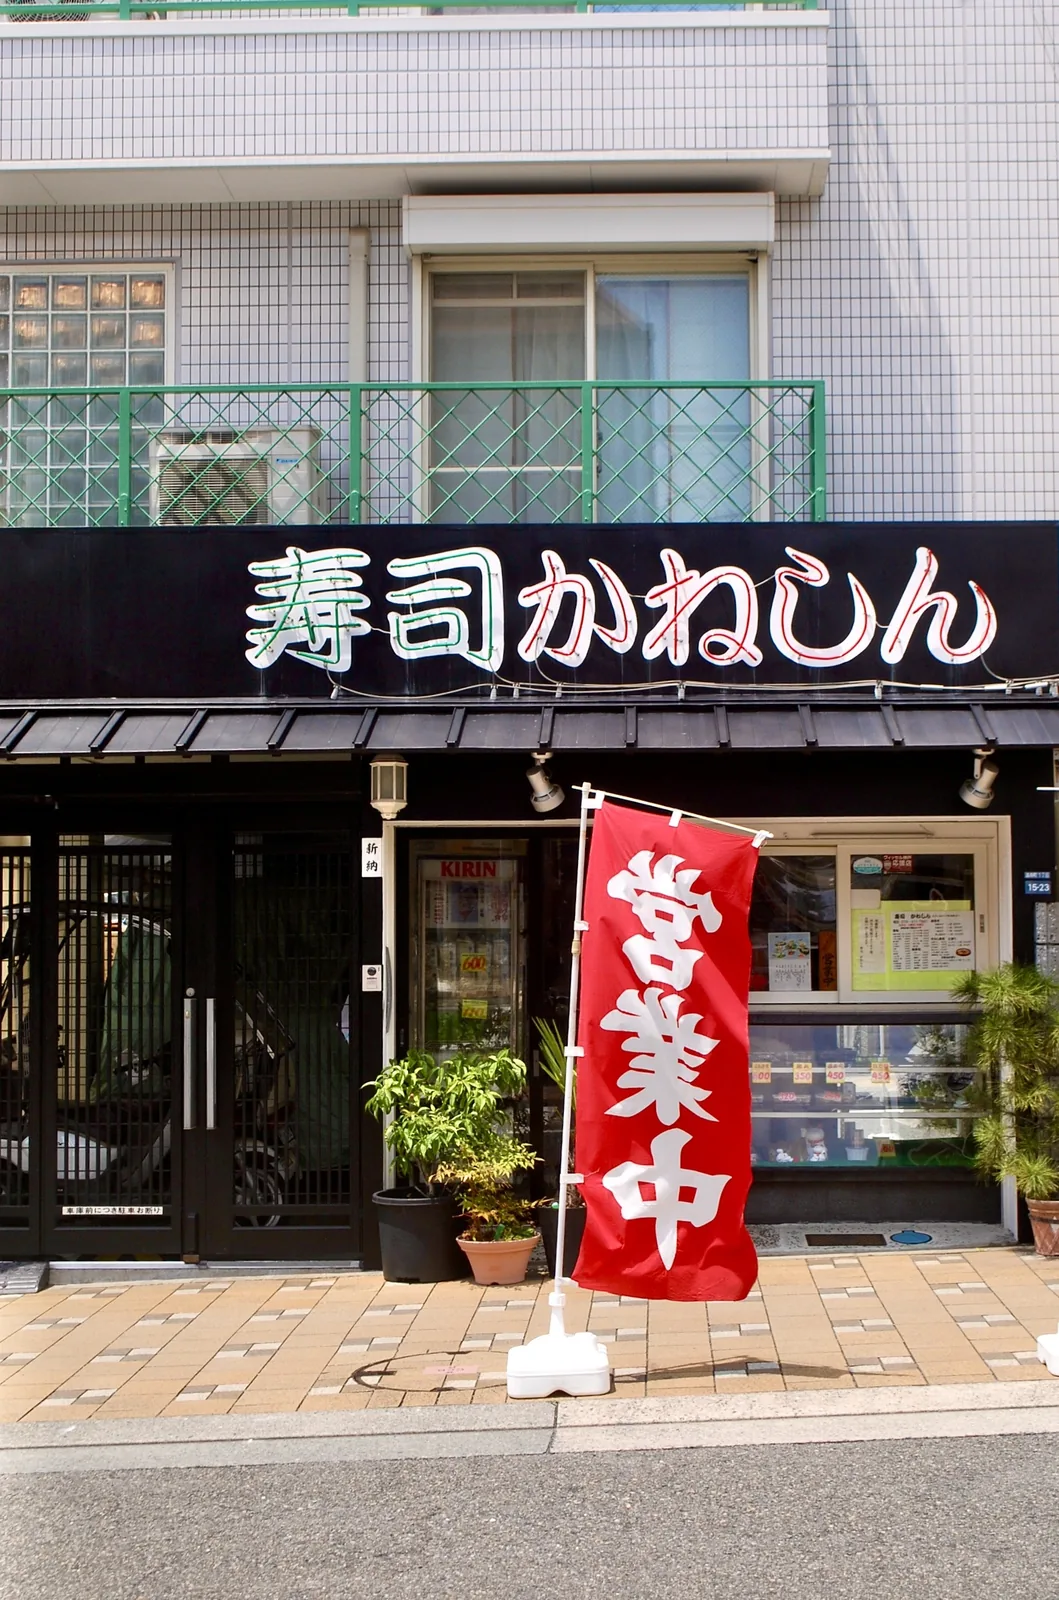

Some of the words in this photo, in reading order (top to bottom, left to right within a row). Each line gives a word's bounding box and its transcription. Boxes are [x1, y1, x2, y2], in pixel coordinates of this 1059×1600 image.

[244, 546, 997, 672] 寿司かねしん
[440, 861, 497, 877] KIRIN
[1028, 883, 1050, 892] 15-23
[600, 849, 732, 1271] 営業中
[827, 1071, 844, 1080] 450
[66, 1206, 160, 1215] 車庫前につき駐車お断り
